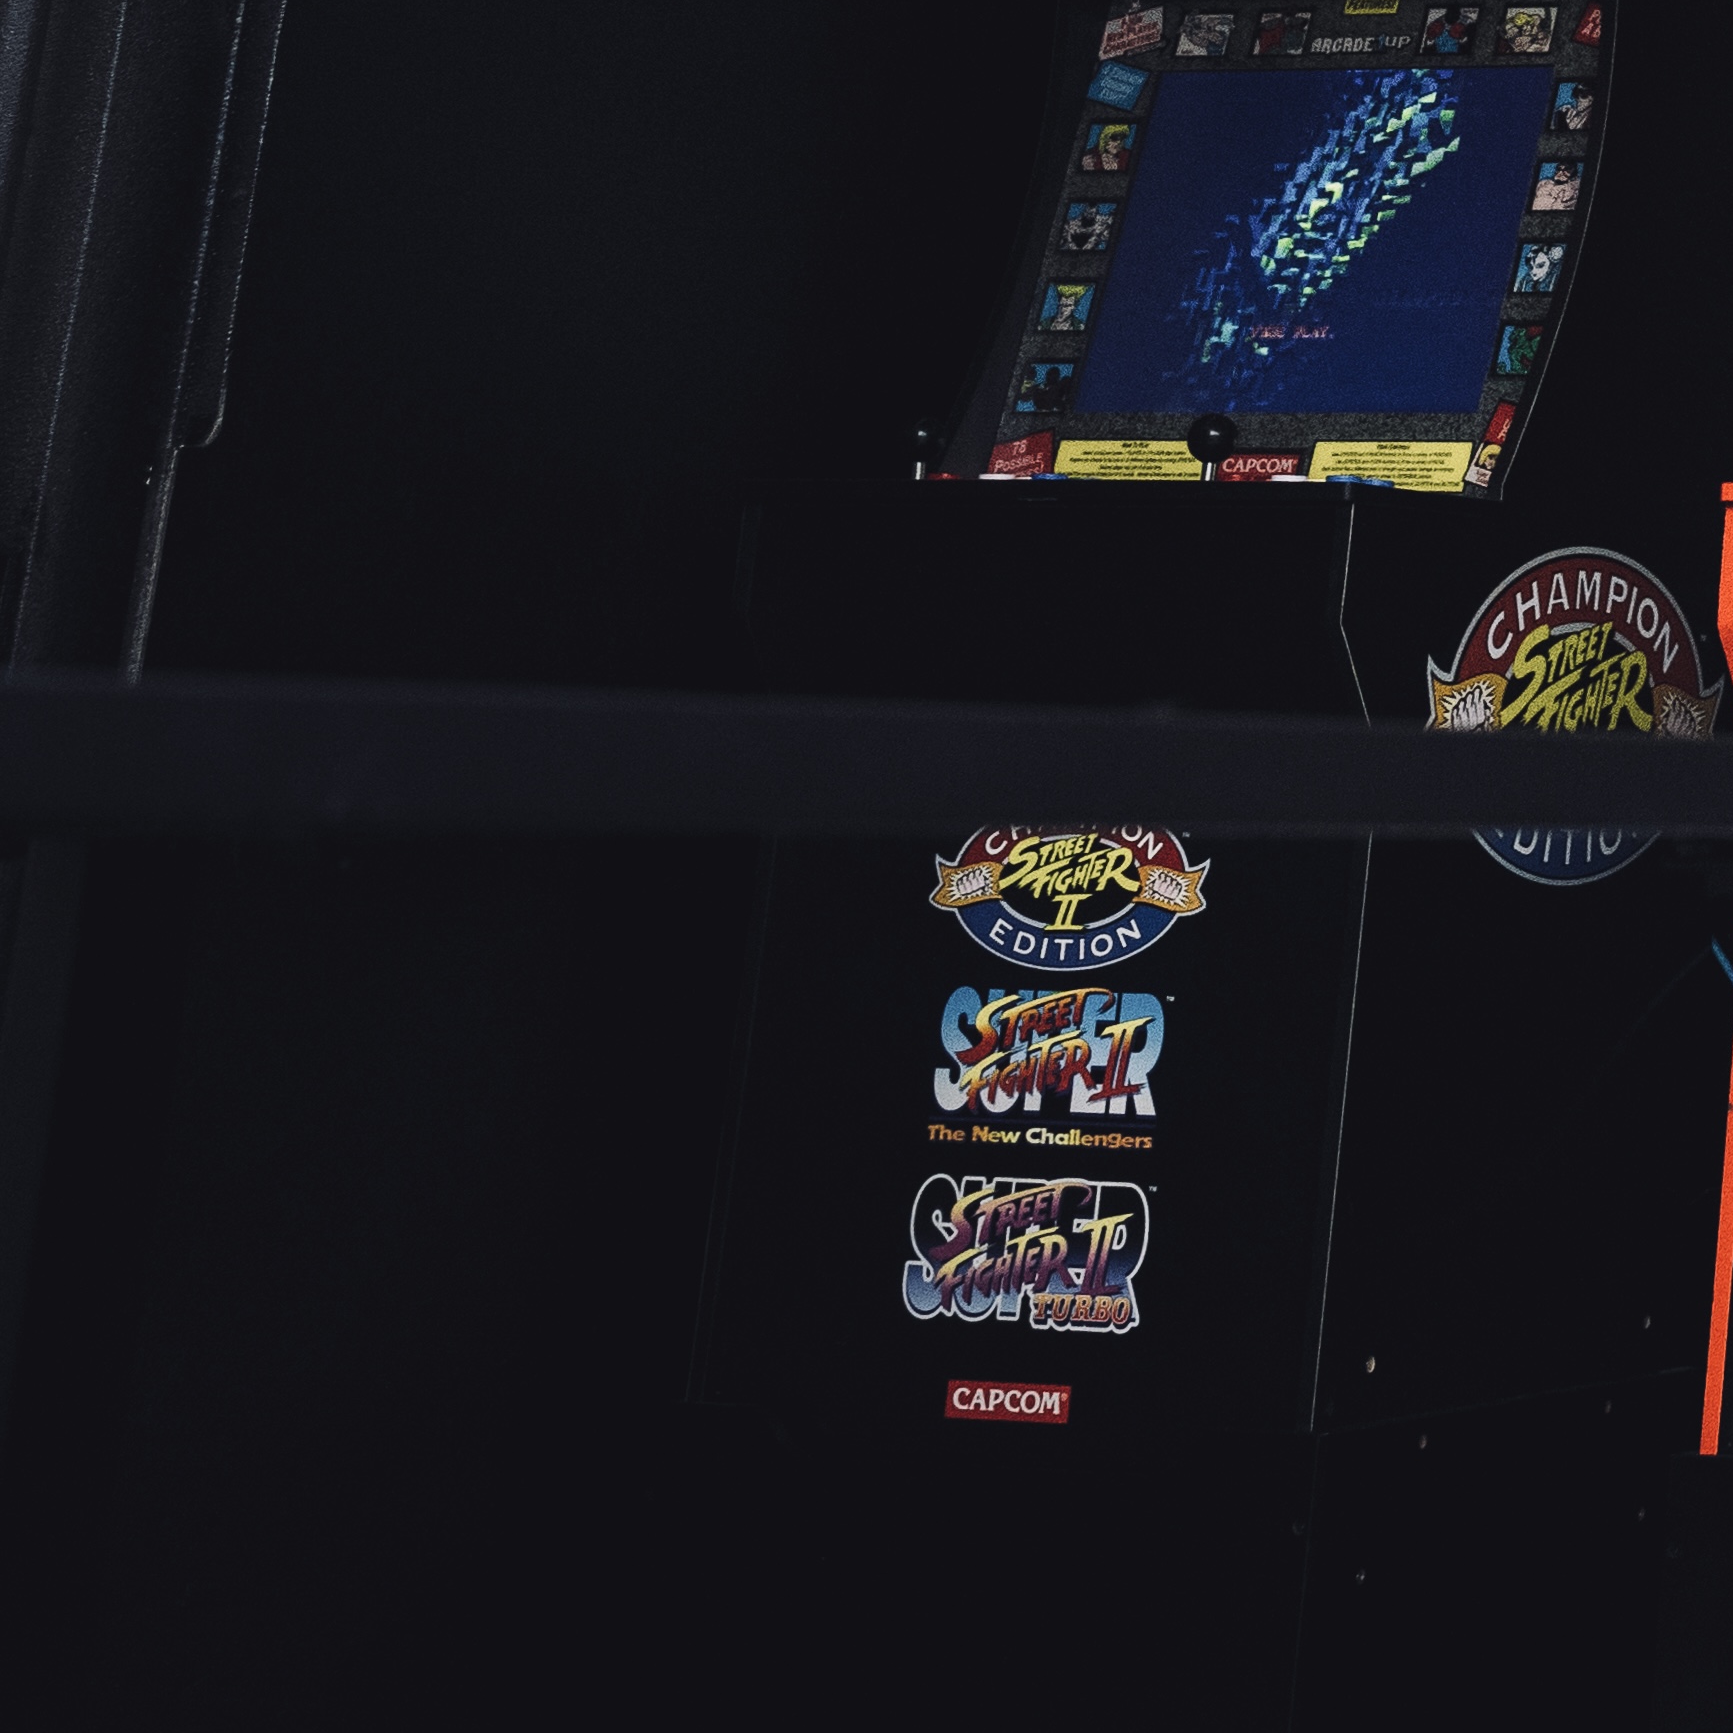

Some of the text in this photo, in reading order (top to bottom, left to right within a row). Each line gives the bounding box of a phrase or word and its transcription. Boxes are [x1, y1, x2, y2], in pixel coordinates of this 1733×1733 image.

[1221, 458, 1296, 475] CAPCOM
[1486, 569, 1680, 675] CHAMPION
[1499, 620, 1614, 731] STREET
[1521, 650, 1654, 733] FIGHTER
[998, 832, 1099, 891] STREET
[1016, 847, 1141, 899] FIGHTER
[988, 917, 1143, 961] EDITION
[1043, 893, 1094, 932] II
[954, 986, 1117, 1066] STREET
[958, 1015, 1156, 1112] FIGHTER II
[927, 1124, 1153, 1149] The New Challengers
[927, 1181, 1093, 1262] STREET
[932, 1225, 1075, 1312] FIGHTER
[1032, 1293, 1132, 1325] TURBO
[952, 1386, 1062, 1416] CAPCOM
